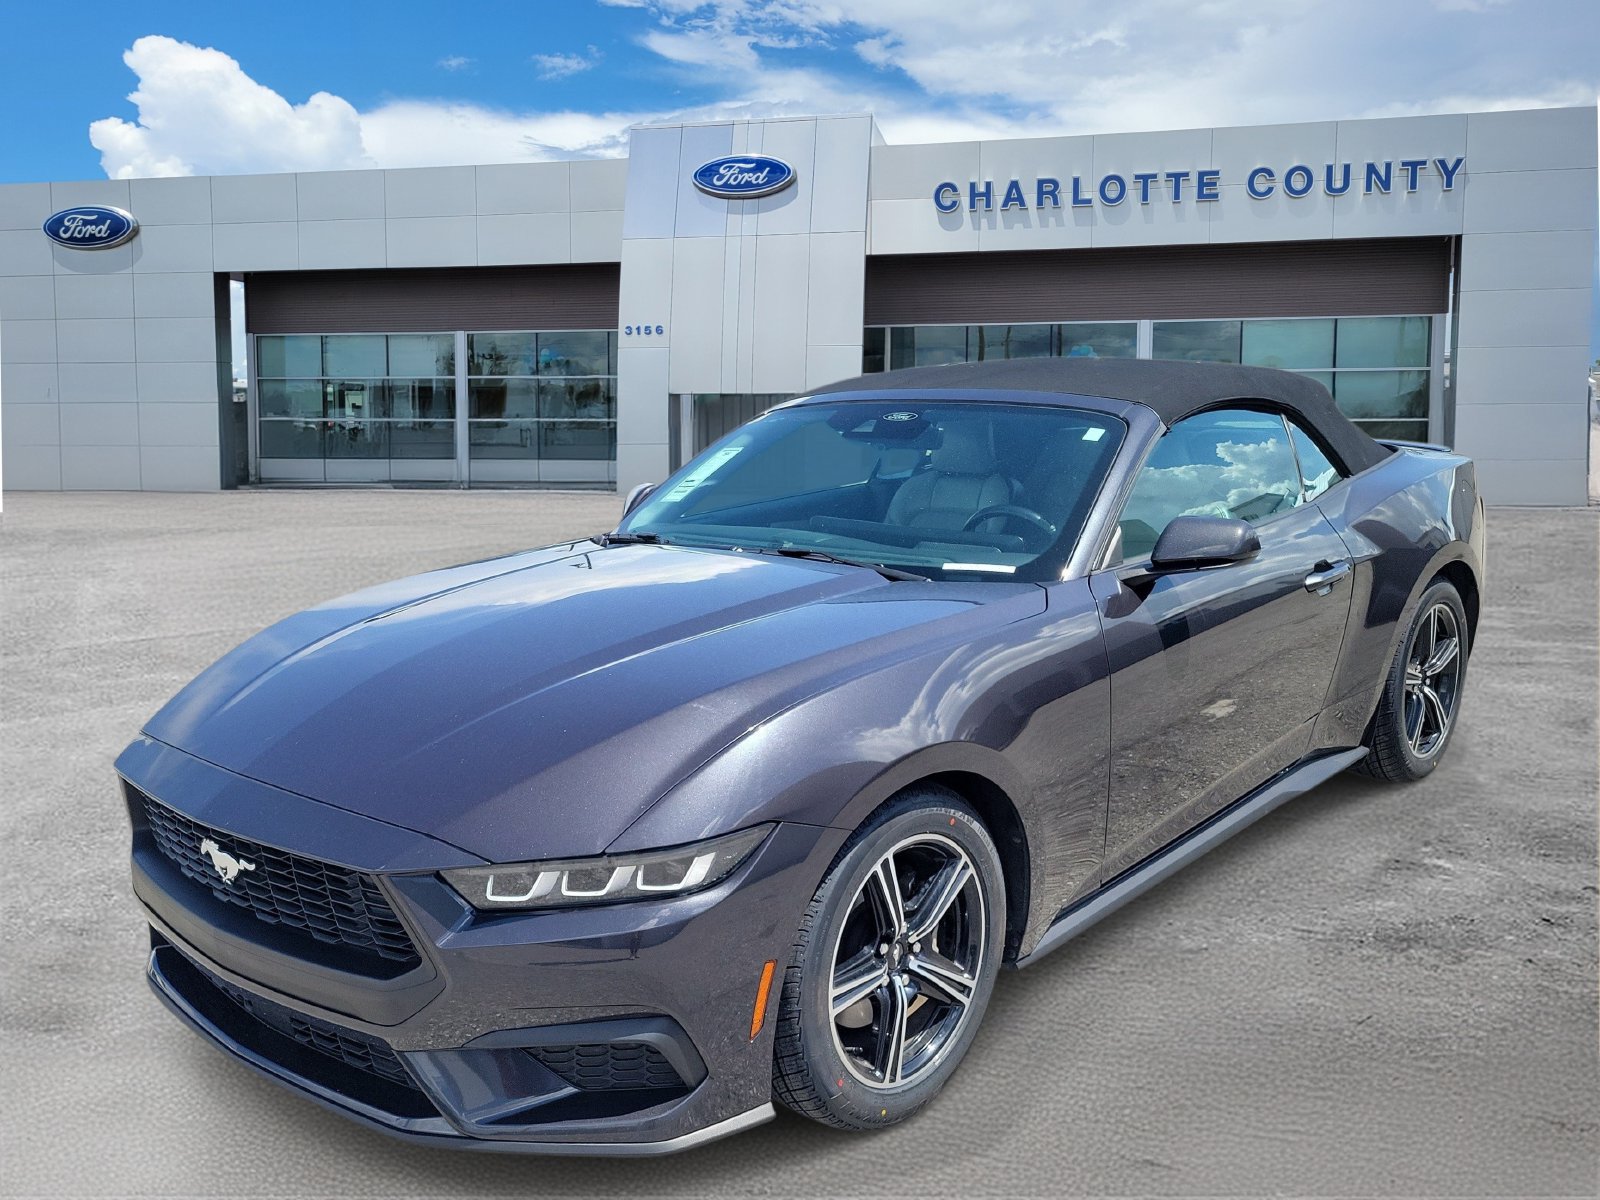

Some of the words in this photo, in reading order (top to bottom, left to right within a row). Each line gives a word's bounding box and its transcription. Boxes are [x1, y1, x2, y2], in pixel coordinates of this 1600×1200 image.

[713, 163, 770, 186] Ford
[933, 169, 1221, 213] CHARLOTTE
[1246, 156, 1466, 200] COUNTY
[59, 214, 112, 239] Ford
[624, 325, 664, 336] 3156
